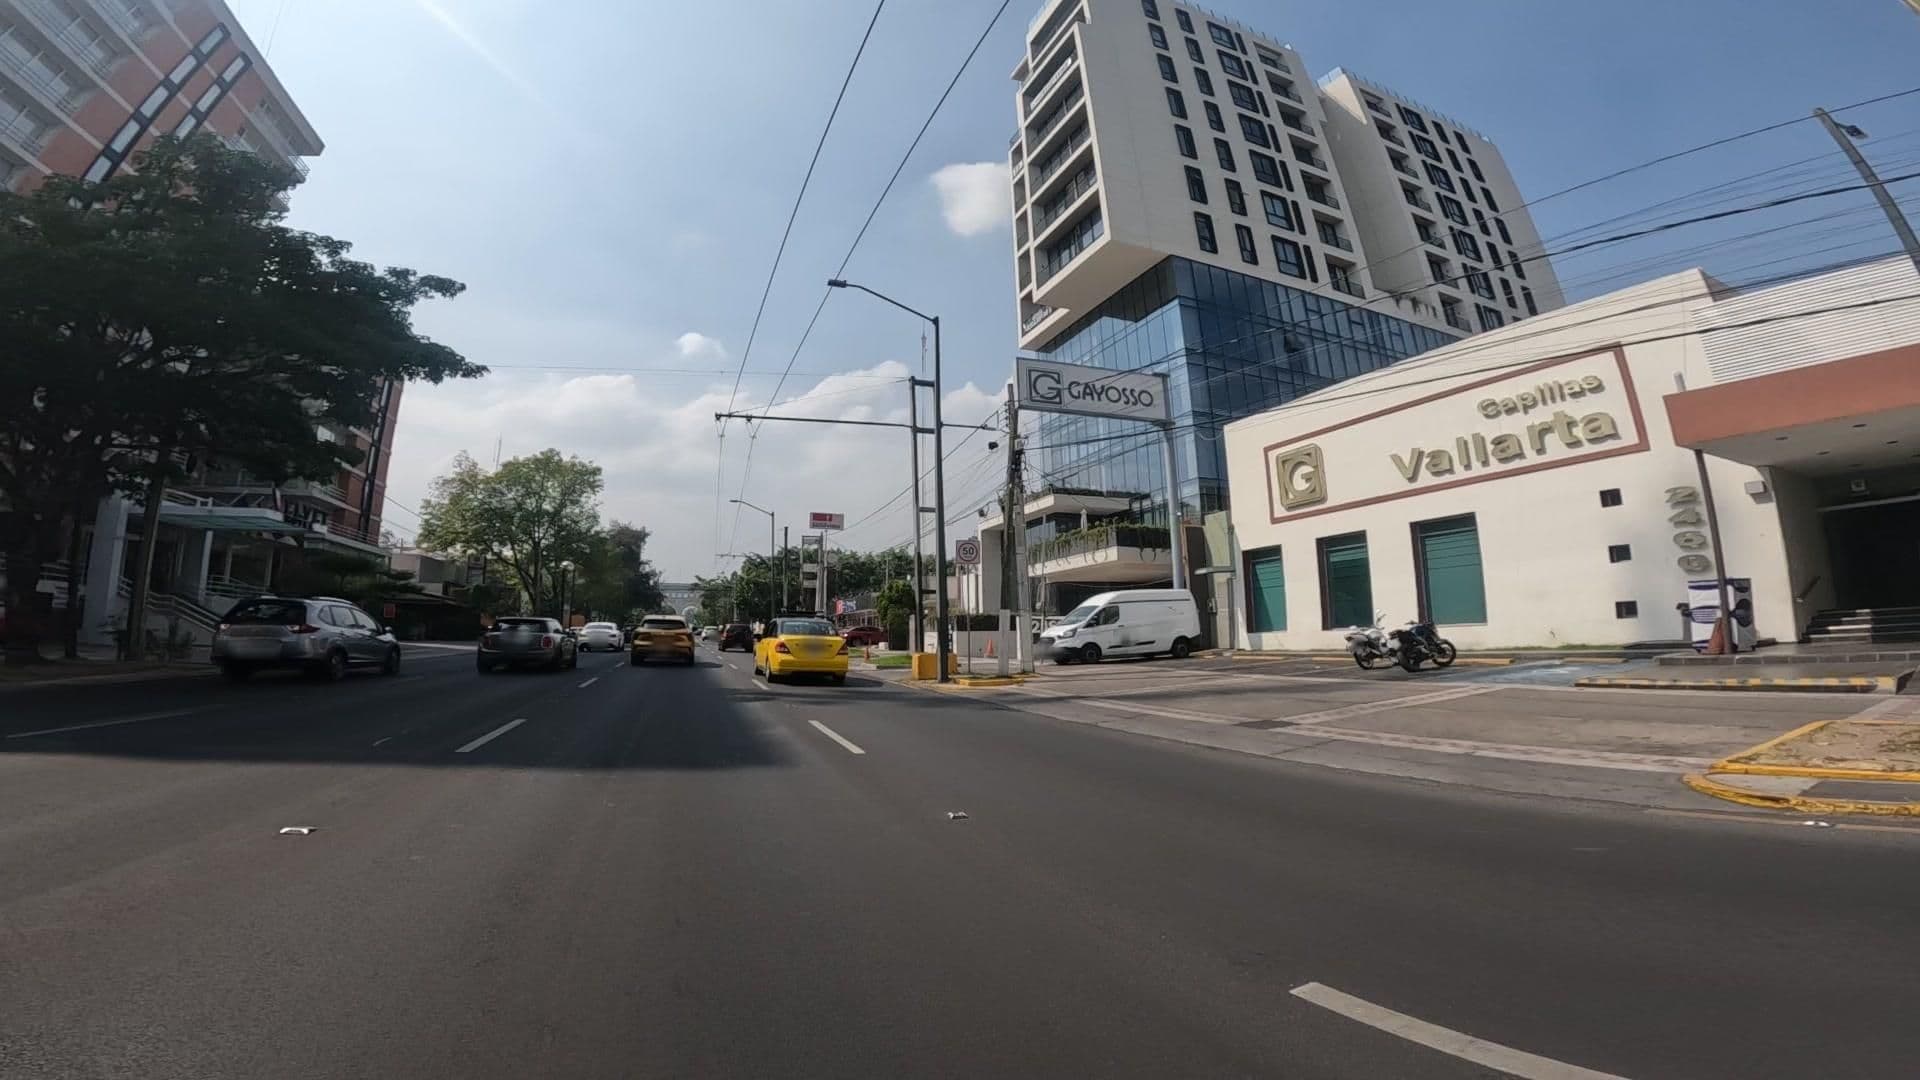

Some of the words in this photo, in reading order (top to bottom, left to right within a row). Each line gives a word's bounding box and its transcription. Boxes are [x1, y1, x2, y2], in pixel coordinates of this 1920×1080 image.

[1031, 371, 1062, 402] G
[1067, 380, 1154, 407] GAYOSSO
[1477, 375, 1605, 419] Capillas
[1390, 410, 1622, 483] Vallarta
[962, 546, 975, 555] 50
